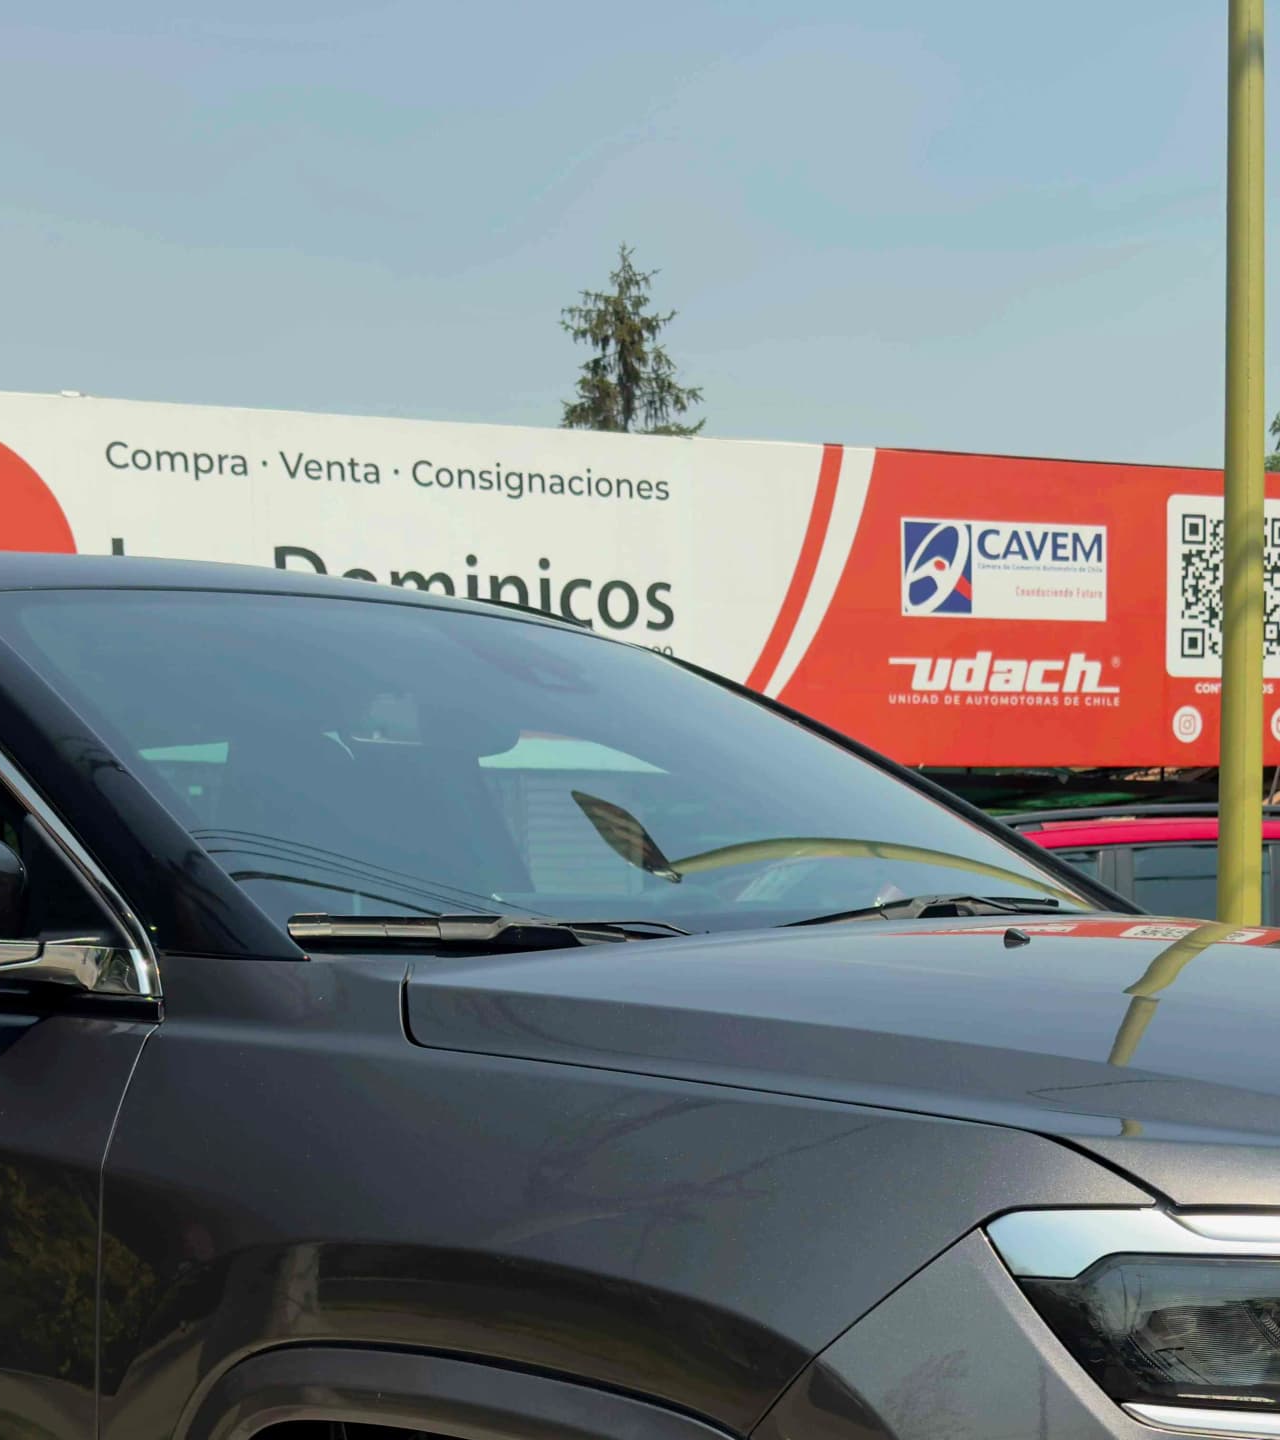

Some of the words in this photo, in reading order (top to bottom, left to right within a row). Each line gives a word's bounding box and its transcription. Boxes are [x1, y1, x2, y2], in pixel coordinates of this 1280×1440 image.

[105, 441, 249, 477] Compra
[278, 450, 382, 485] Venta
[410, 459, 671, 501] Consignaciones
[977, 528, 1103, 563] CAVEM
[888, 694, 939, 705] UNIDAD
[944, 695, 961, 706] DE
[967, 695, 1059, 707] AUTOMOTORAS
[1064, 696, 1080, 707] DE
[1084, 697, 1120, 708] CHILE
